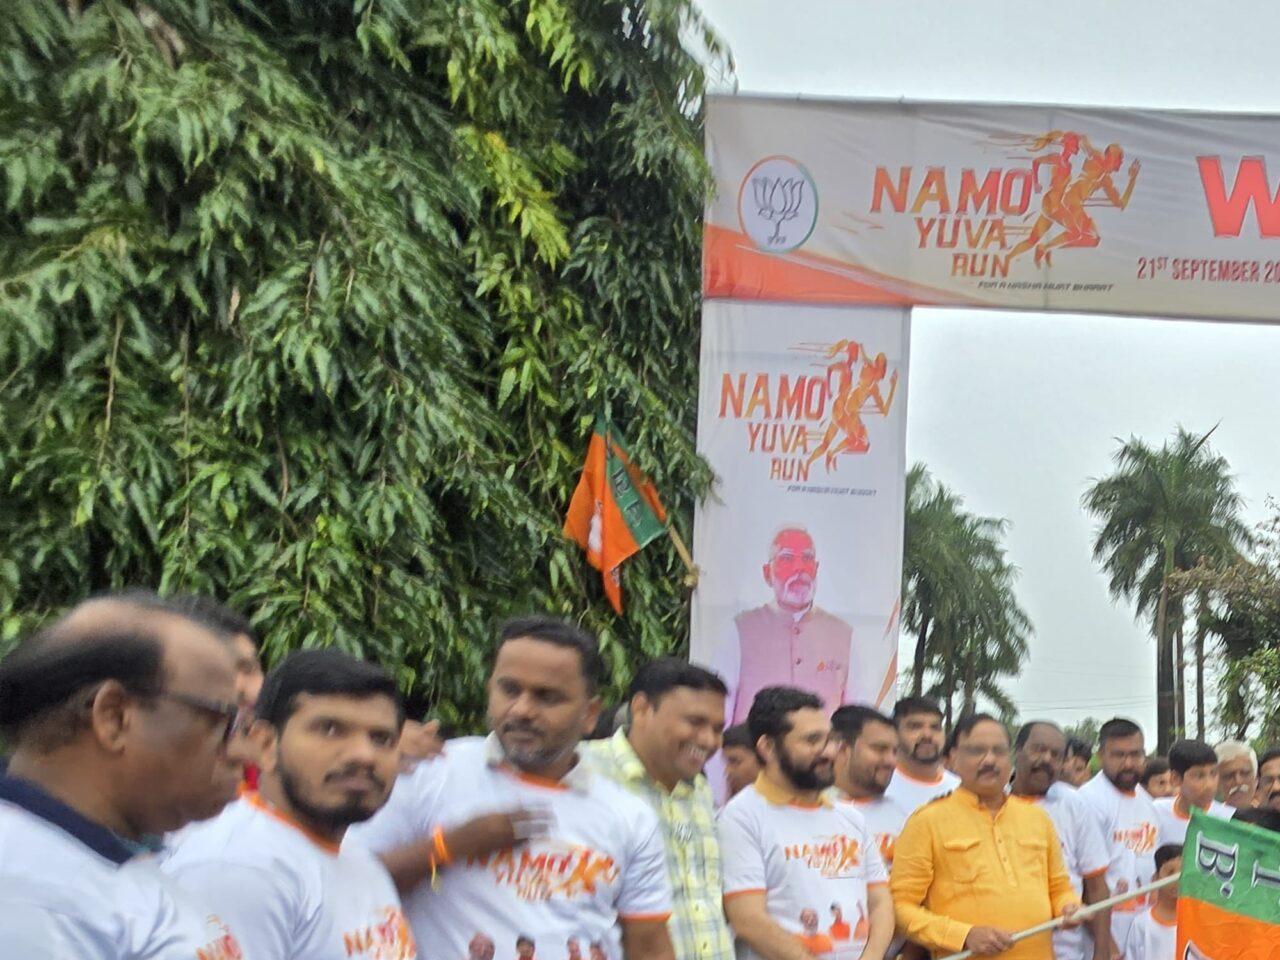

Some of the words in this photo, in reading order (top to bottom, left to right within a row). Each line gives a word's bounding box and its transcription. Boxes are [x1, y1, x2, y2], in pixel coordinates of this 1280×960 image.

[869, 166, 1034, 216] NAMO
[916, 216, 1010, 250] YUVA
[950, 252, 1011, 279] RUN
[1136, 256, 1168, 280] 21ST
[1171, 258, 1259, 283] SEPTEMBER
[719, 372, 830, 421] NAMO
[748, 423, 810, 455] YUVA
[769, 457, 810, 482] RUN
